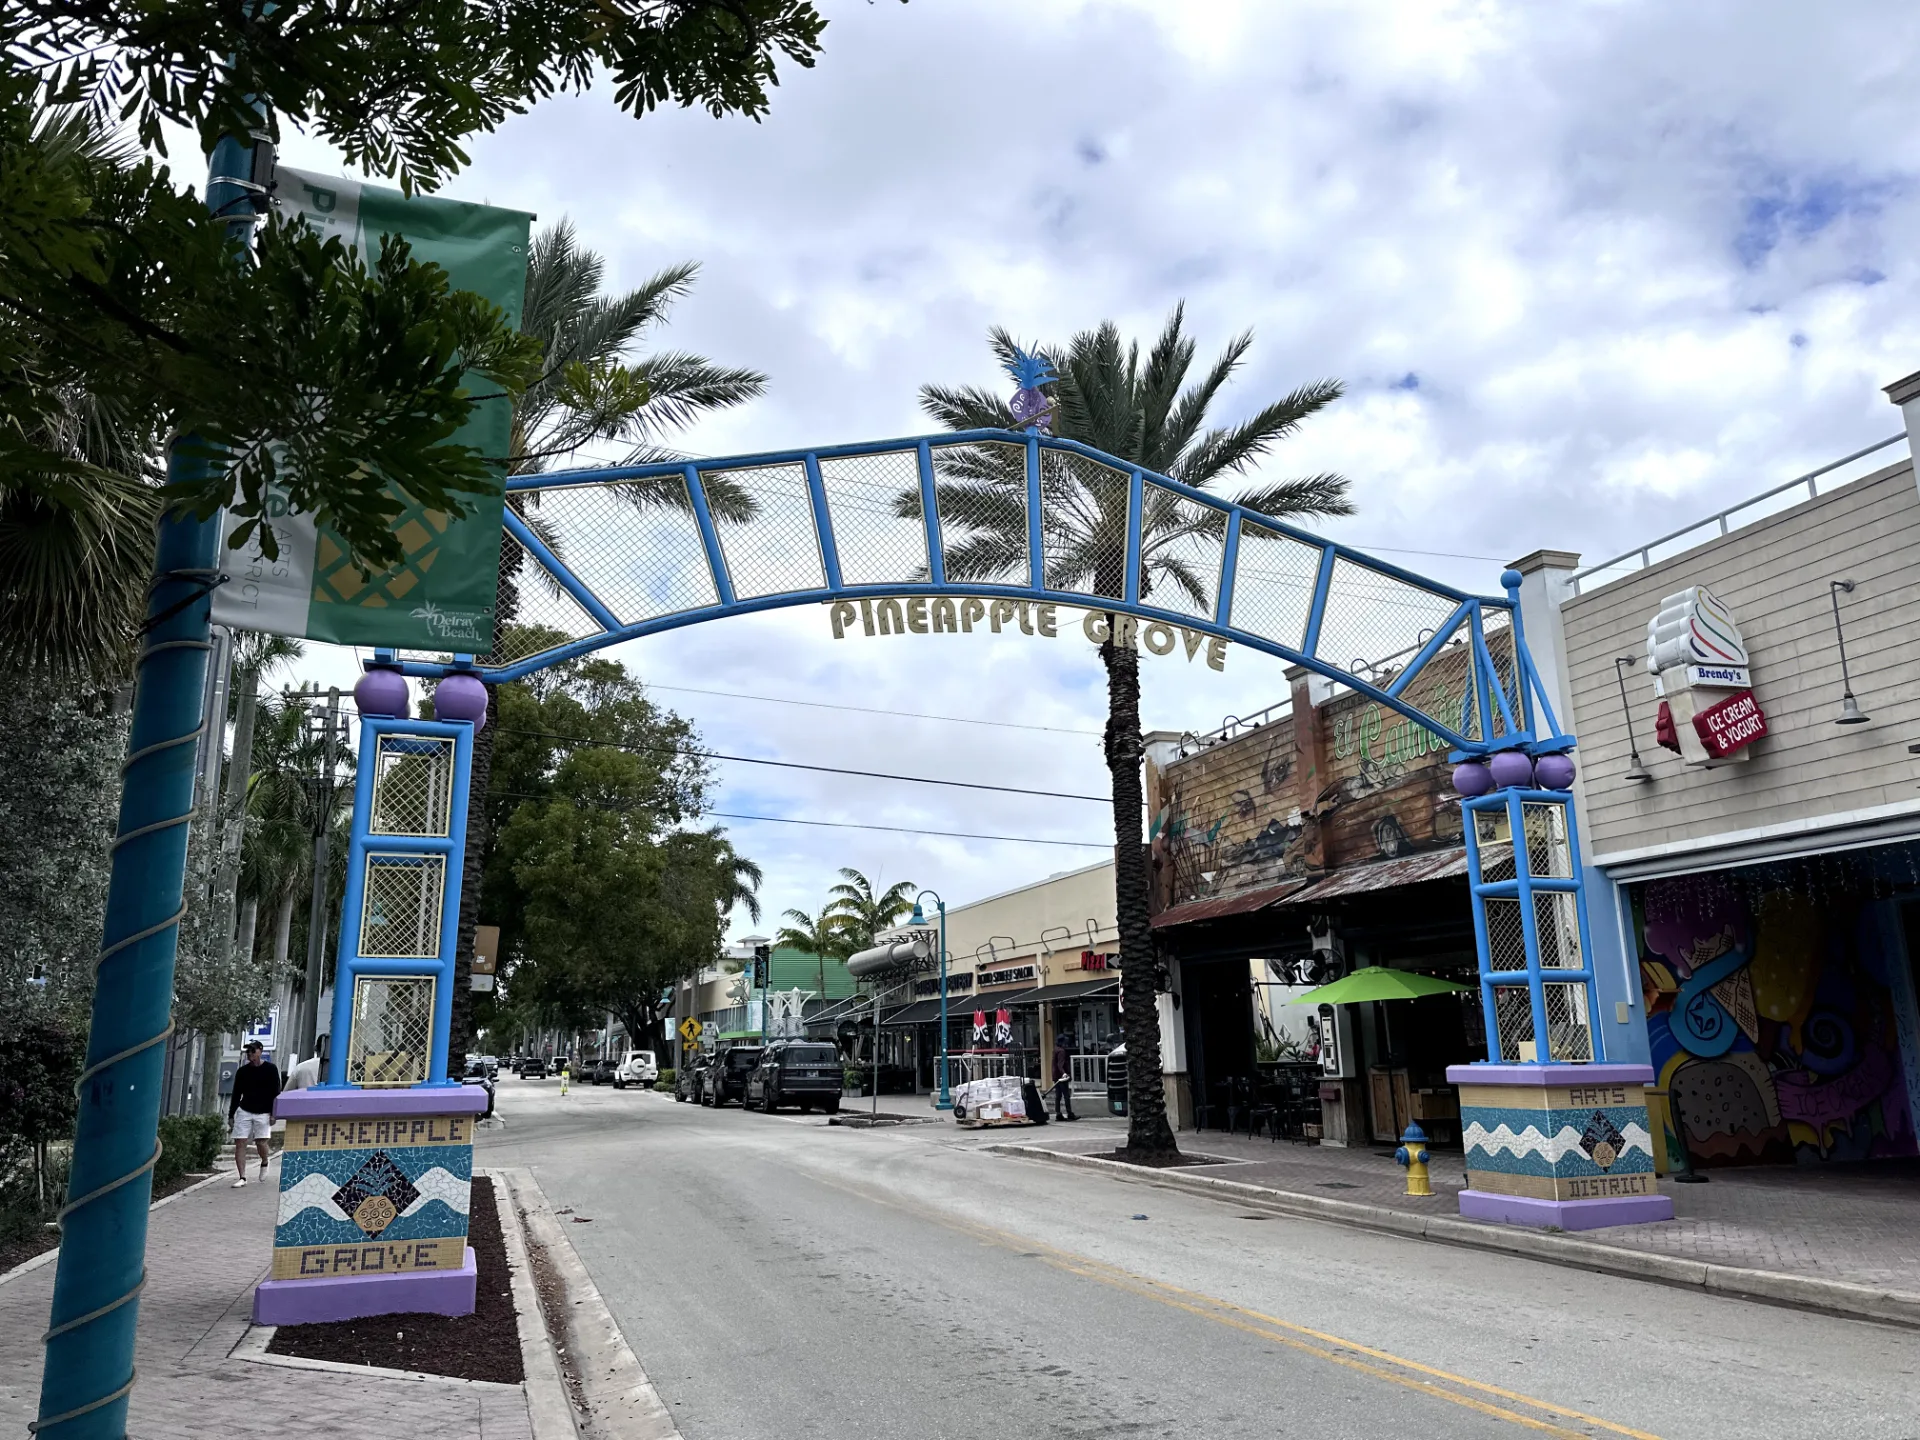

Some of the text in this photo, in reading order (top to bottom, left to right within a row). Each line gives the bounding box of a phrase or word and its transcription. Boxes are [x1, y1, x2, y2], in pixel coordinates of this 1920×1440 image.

[272, 527, 293, 578] ARTS
[432, 613, 481, 628] Delray
[438, 625, 483, 641] Beach
[830, 598, 1229, 672] PINEAPPLE GROVE
[1698, 667, 1742, 681] Brendy's
[1706, 696, 1756, 733] ICE CREAM
[1333, 712, 1356, 760] El
[1716, 713, 1763, 749] & YOGURT
[1569, 1087, 1626, 1106] ARTS
[303, 1118, 464, 1146] PINEAPPLE
[1567, 1176, 1647, 1198] DISTRICT
[299, 1243, 438, 1274] GROVE
